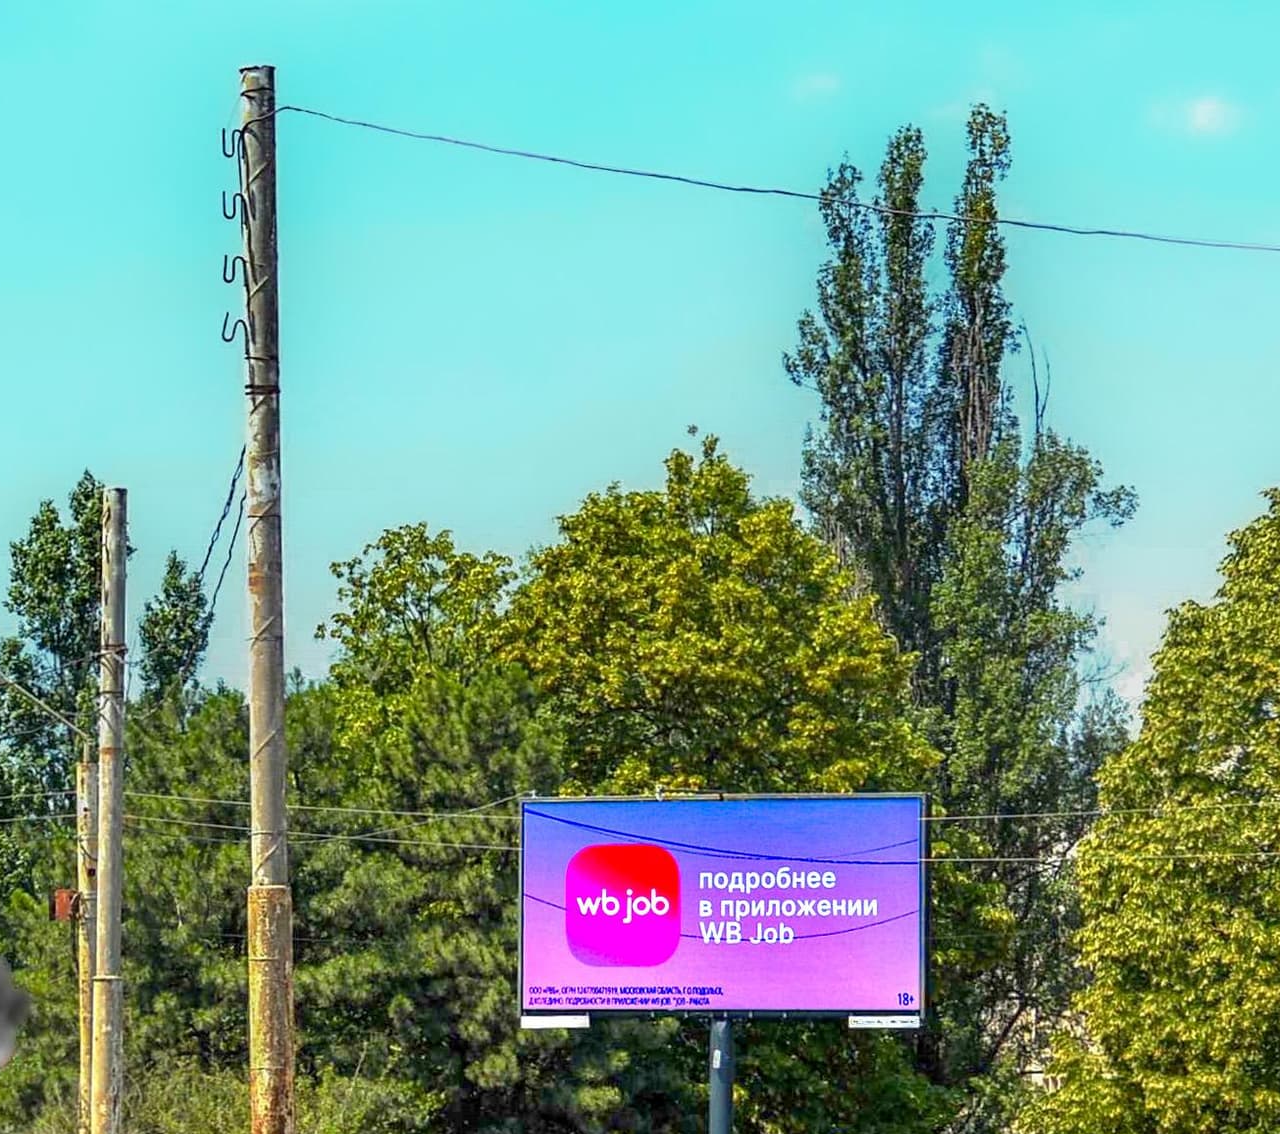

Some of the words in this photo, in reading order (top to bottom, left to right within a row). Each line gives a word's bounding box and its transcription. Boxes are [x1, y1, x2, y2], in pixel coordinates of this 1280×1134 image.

[699, 867, 836, 894] подробнее
[576, 888, 620, 916] wb
[622, 888, 670, 924] job
[699, 899, 714, 917] в
[720, 899, 878, 921] приложении
[699, 921, 742, 944] WB
[749, 922, 795, 944] Job
[897, 992, 915, 1006] 18+
